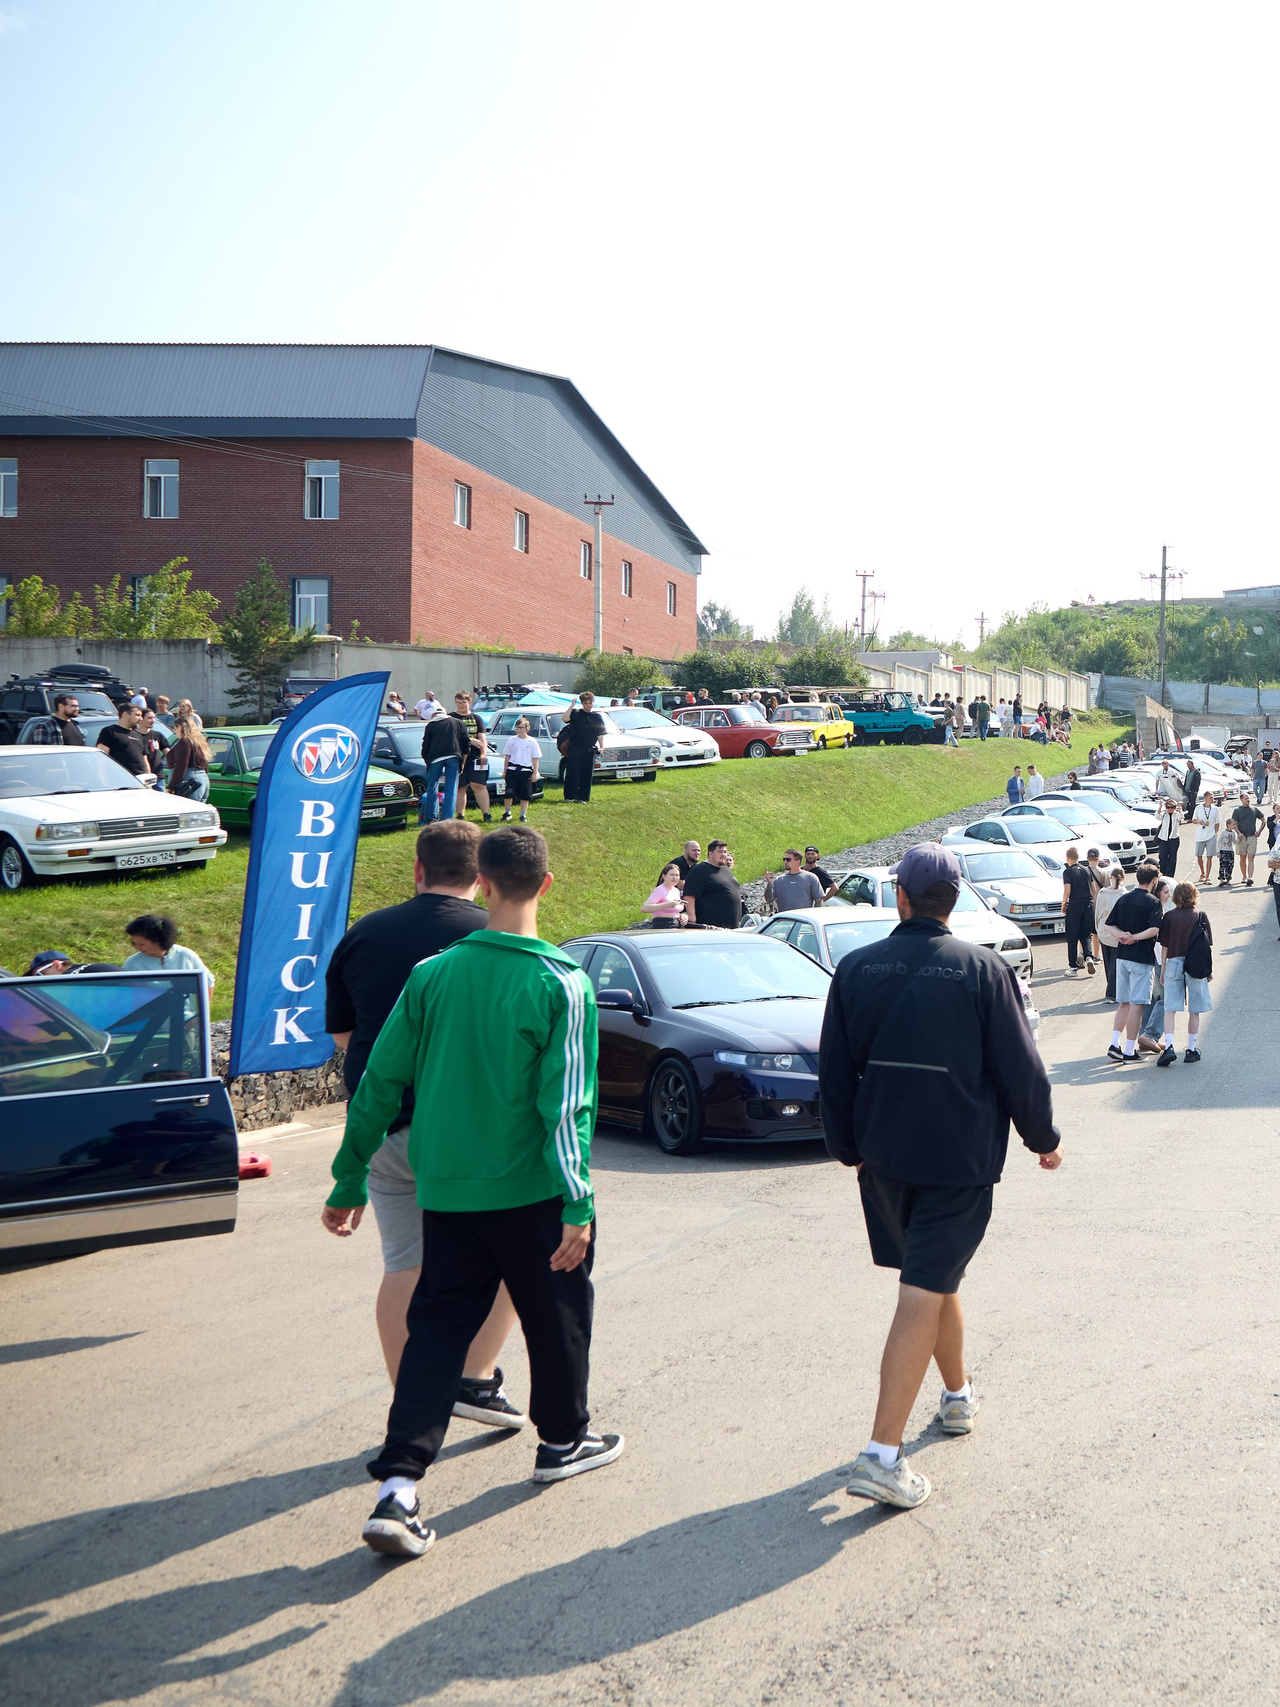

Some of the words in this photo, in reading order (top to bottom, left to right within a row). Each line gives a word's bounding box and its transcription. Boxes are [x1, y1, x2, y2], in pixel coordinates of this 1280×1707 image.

[120, 855, 158, 867] О625ХВ
[159, 852, 175, 861] 124
[269, 800, 336, 1046] BUICK
[861, 963, 894, 975] new
[895, 960, 965, 981] blance
